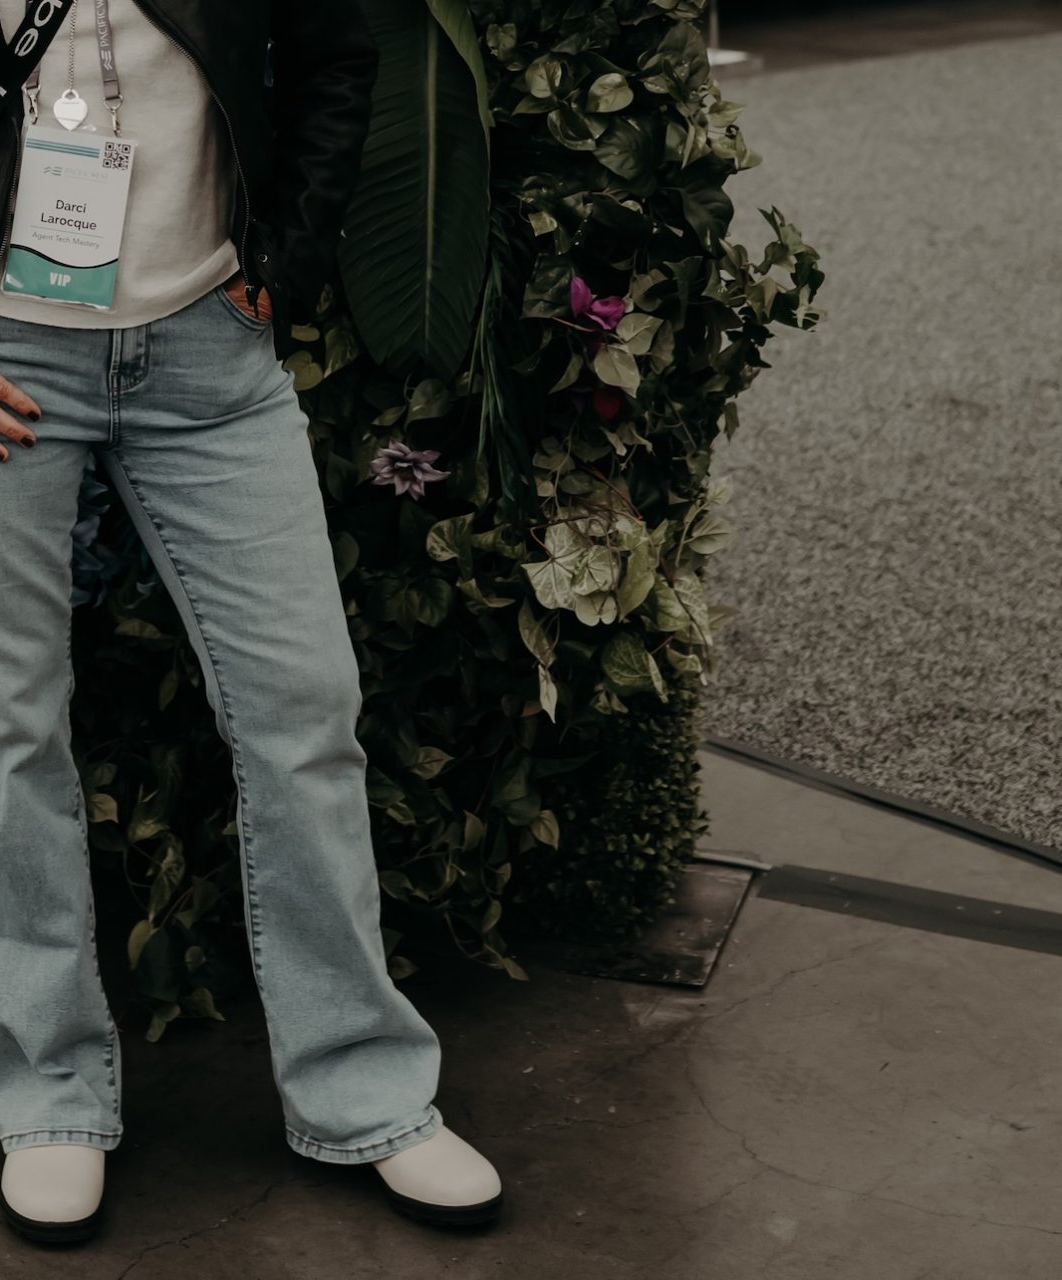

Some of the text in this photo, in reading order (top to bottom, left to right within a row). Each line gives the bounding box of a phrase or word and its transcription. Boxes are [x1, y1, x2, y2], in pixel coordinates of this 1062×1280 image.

[96, 9, 110, 48] PACIFIC
[55, 199, 87, 214] Darci
[41, 212, 97, 231] Larocque
[32, 231, 100, 249] Agent Tech Mastery
[49, 271, 72, 287] VIP
